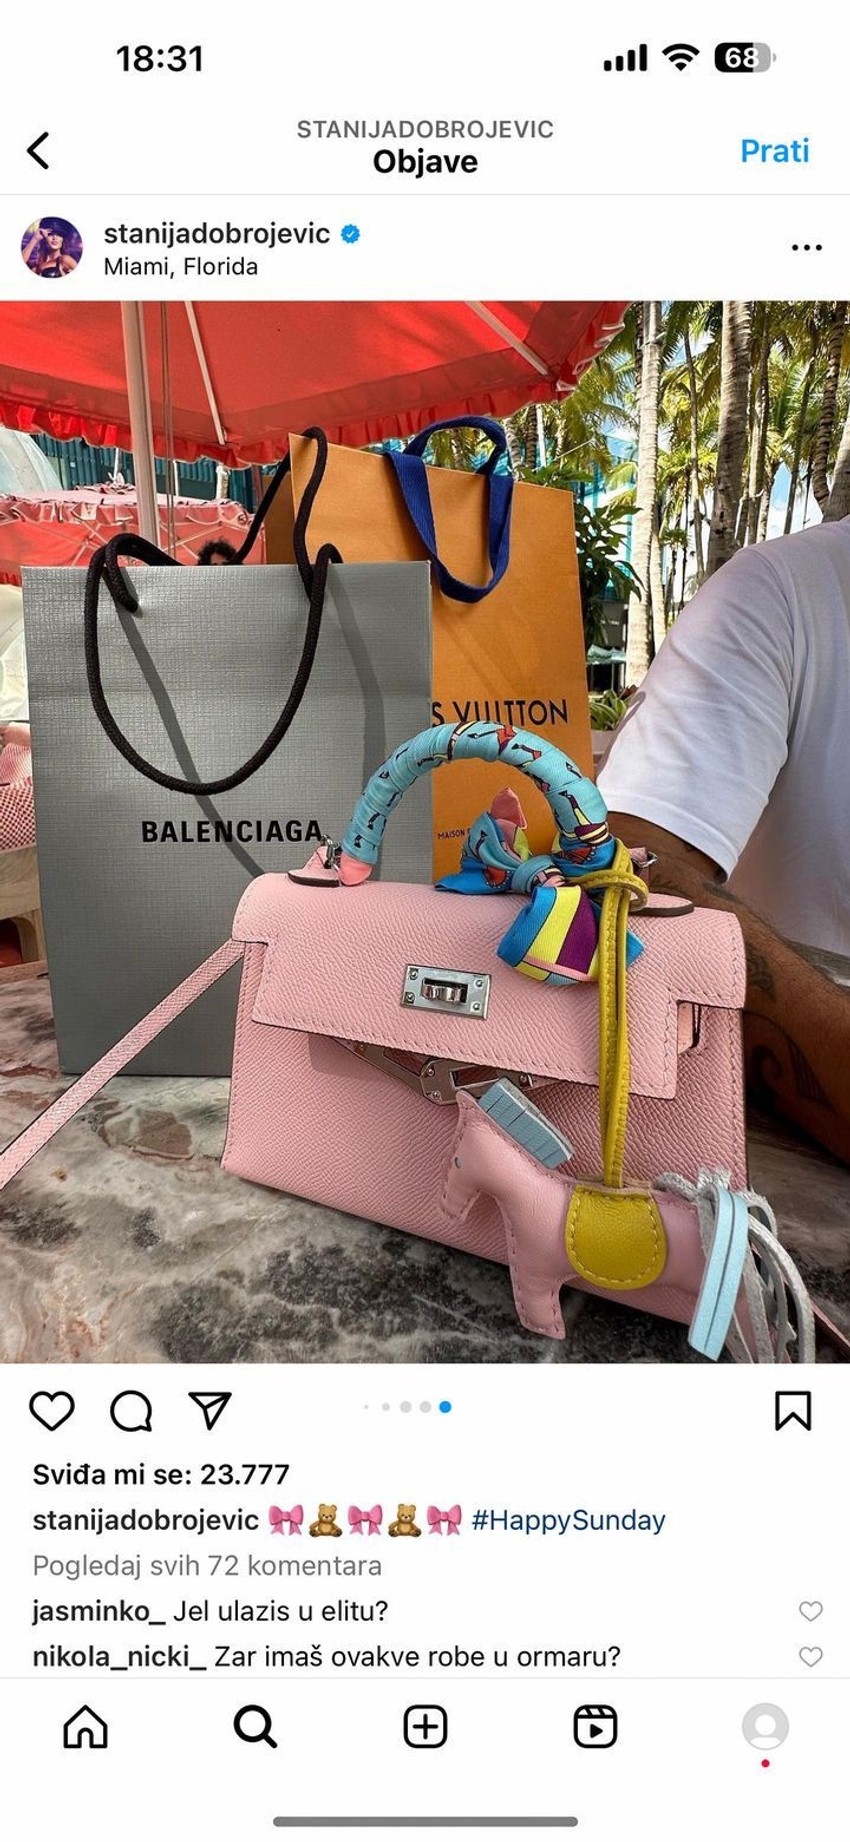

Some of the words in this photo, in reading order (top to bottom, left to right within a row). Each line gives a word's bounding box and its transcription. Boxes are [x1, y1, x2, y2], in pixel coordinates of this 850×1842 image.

[117, 45, 202, 72] 18:31
[725, 47, 760, 68] 68
[297, 120, 554, 139] STANIJADOBROJEVIC
[374, 148, 478, 179] Objave
[742, 137, 810, 163] Prati
[104, 221, 331, 249] stanijadobrojevic
[104, 257, 175, 279] Miami,
[184, 257, 258, 276] Florida
[452, 699, 568, 726] VUITTON
[141, 820, 323, 843] BALENCIAGA
[437, 829, 465, 840] MAISON
[33, 1463, 106, 1486] Sviđa
[115, 1463, 145, 1486] mi
[154, 1468, 192, 1486] se:
[201, 1464, 290, 1486] 23.777
[32, 1508, 259, 1536] stanijadobrojevic
[472, 1508, 666, 1536] #HappySunday
[33, 1554, 141, 1581] Pogledaj
[150, 1554, 200, 1576] svih
[208, 1555, 239, 1576] 72
[248, 1554, 382, 1576] komentara
[32, 1599, 166, 1627] jasminko_
[174, 1600, 209, 1622] Jel
[218, 1600, 290, 1622] ulazis
[298, 1605, 313, 1622] u
[321, 1600, 389, 1622] elitu?
[33, 1644, 207, 1672] nikola_nicki_
[215, 1645, 257, 1668] Zar
[265, 1644, 323, 1668] imaš
[331, 1645, 420, 1668] ovakve
[428, 1645, 485, 1668] robe
[493, 1650, 508, 1667] u
[517, 1645, 621, 1668] ormaru?
